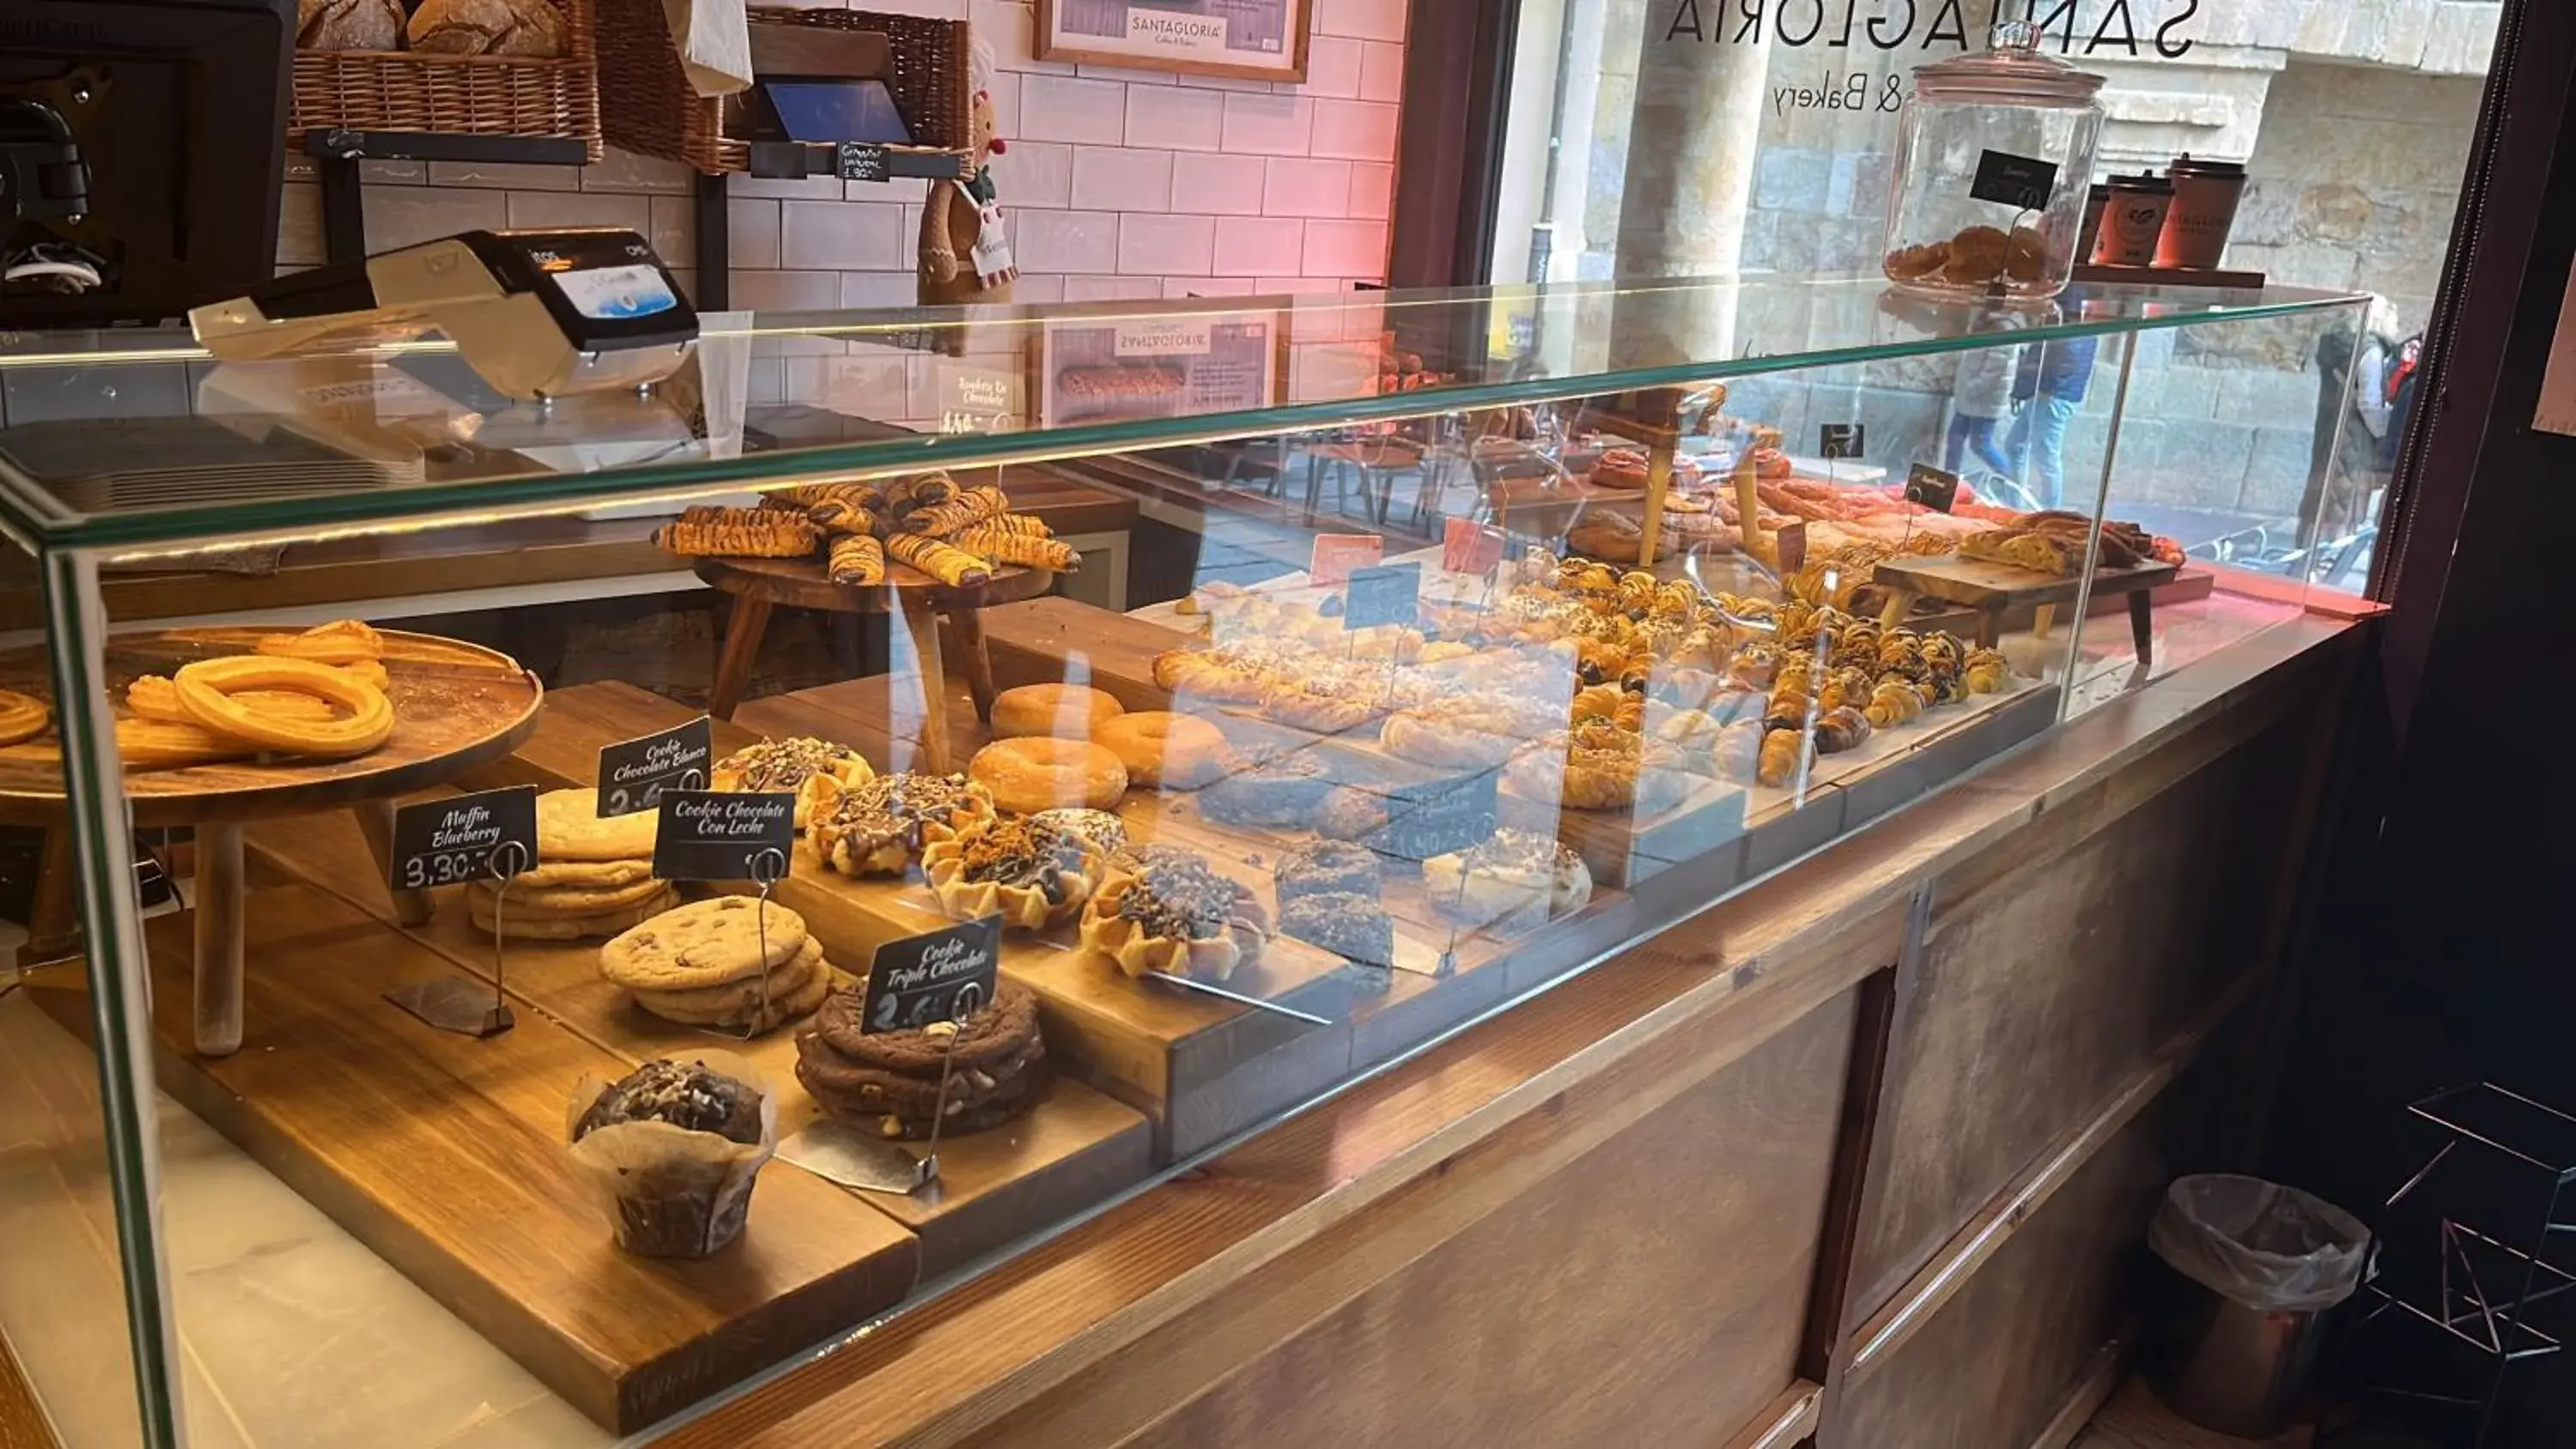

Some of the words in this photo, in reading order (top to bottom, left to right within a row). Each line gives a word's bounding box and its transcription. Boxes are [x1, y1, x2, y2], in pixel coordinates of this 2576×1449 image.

[646, 739, 681, 761] Cookie
[614, 758, 671, 783] Chocolate
[672, 746, 707, 767] Blanco
[440, 805, 490, 830] Muffin
[675, 798, 722, 819] Cookie
[726, 800, 785, 818] Chocolate
[432, 827, 501, 848] Blueberry
[697, 819, 726, 835] Con
[728, 818, 765, 836] Leche
[920, 937, 965, 962] Cookie
[887, 962, 927, 988] Triple
[930, 949, 989, 979] Chocolate
